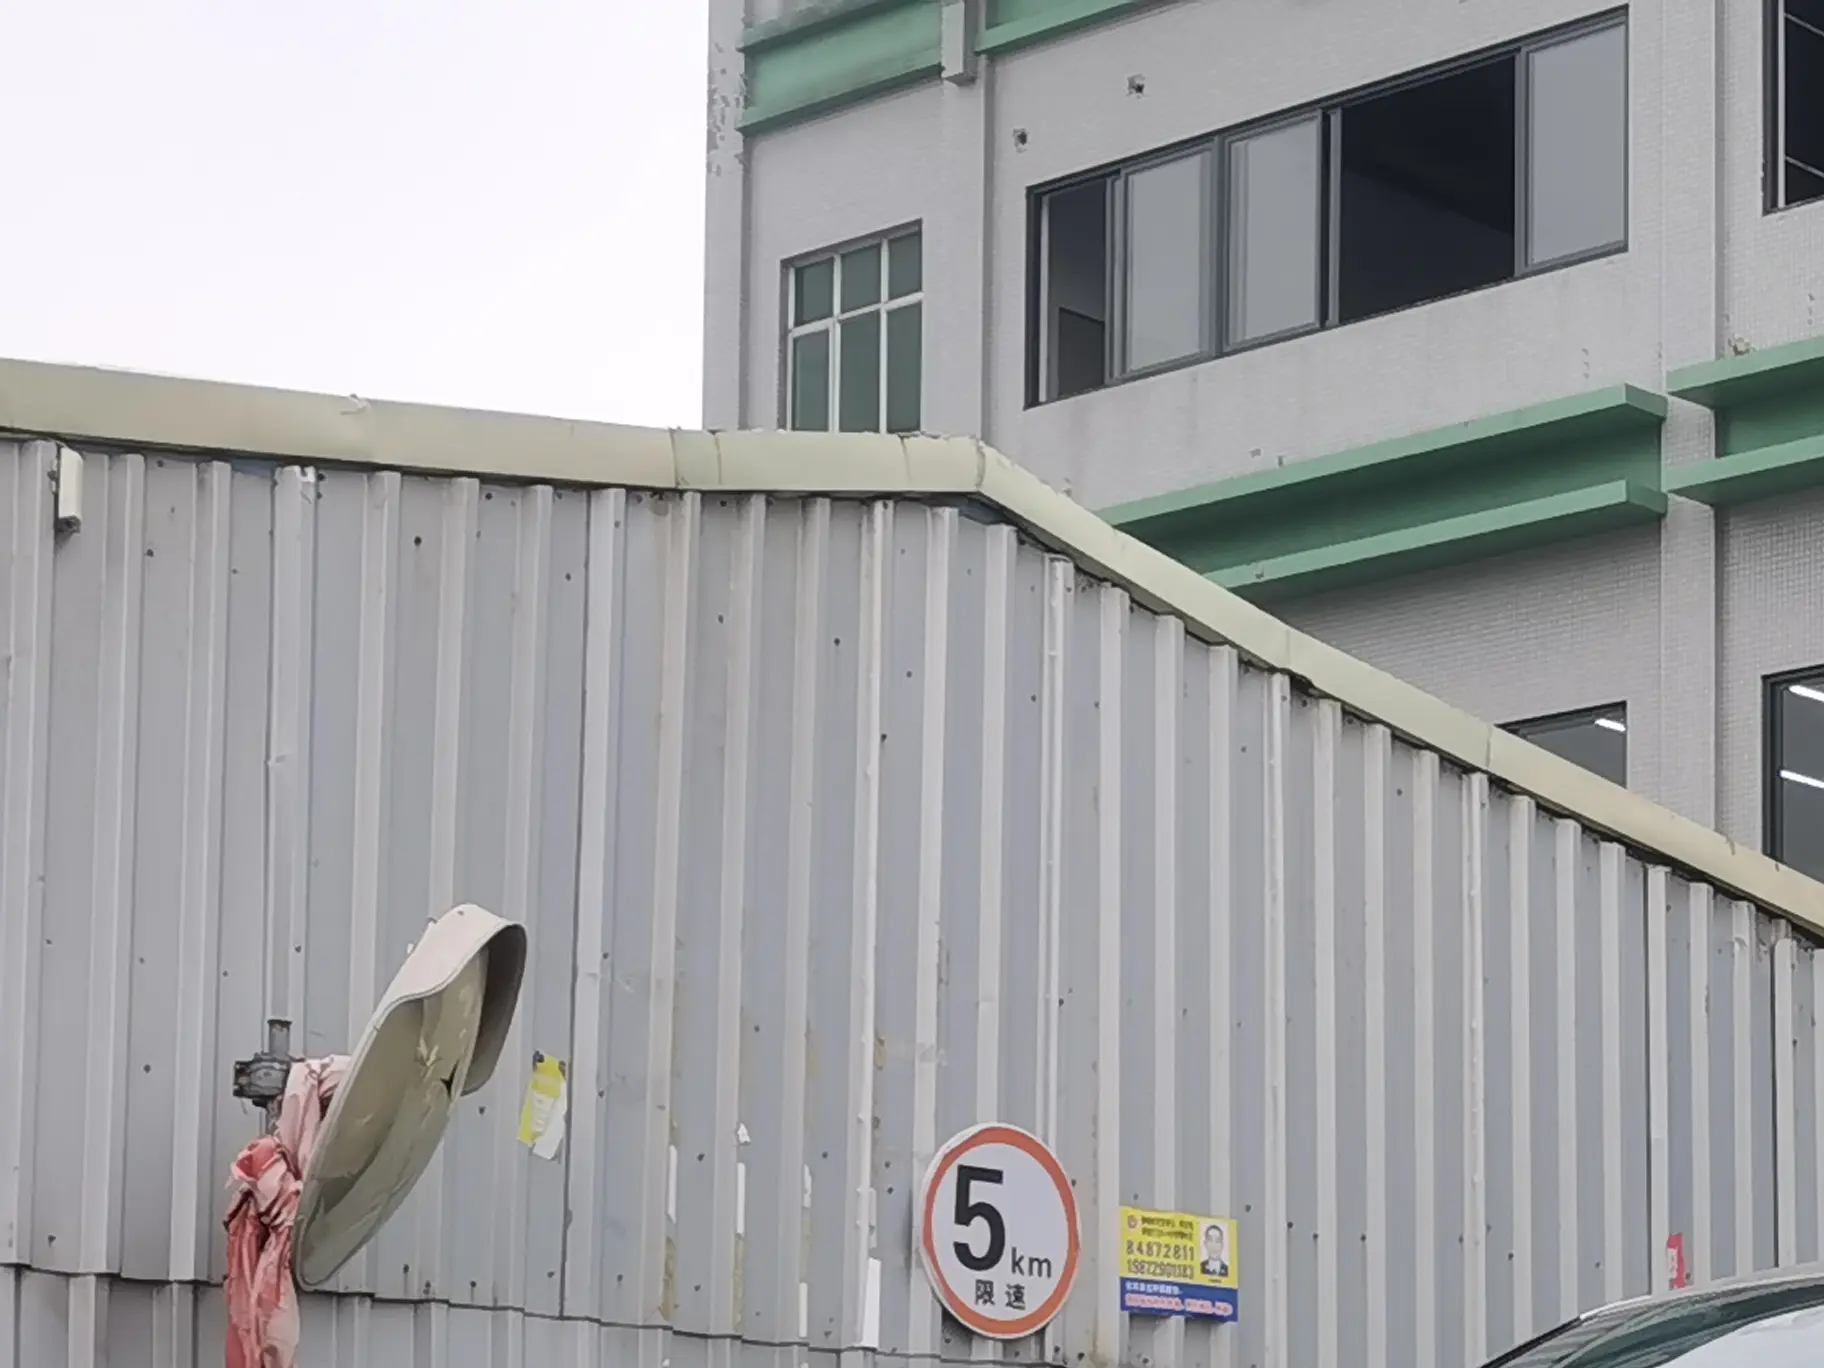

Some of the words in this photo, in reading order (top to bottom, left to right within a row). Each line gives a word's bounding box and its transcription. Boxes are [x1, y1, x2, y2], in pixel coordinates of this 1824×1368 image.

[953, 1164, 1006, 1272] 5
[1010, 1246, 1053, 1278] km
[974, 1279, 1027, 1311] 限速
